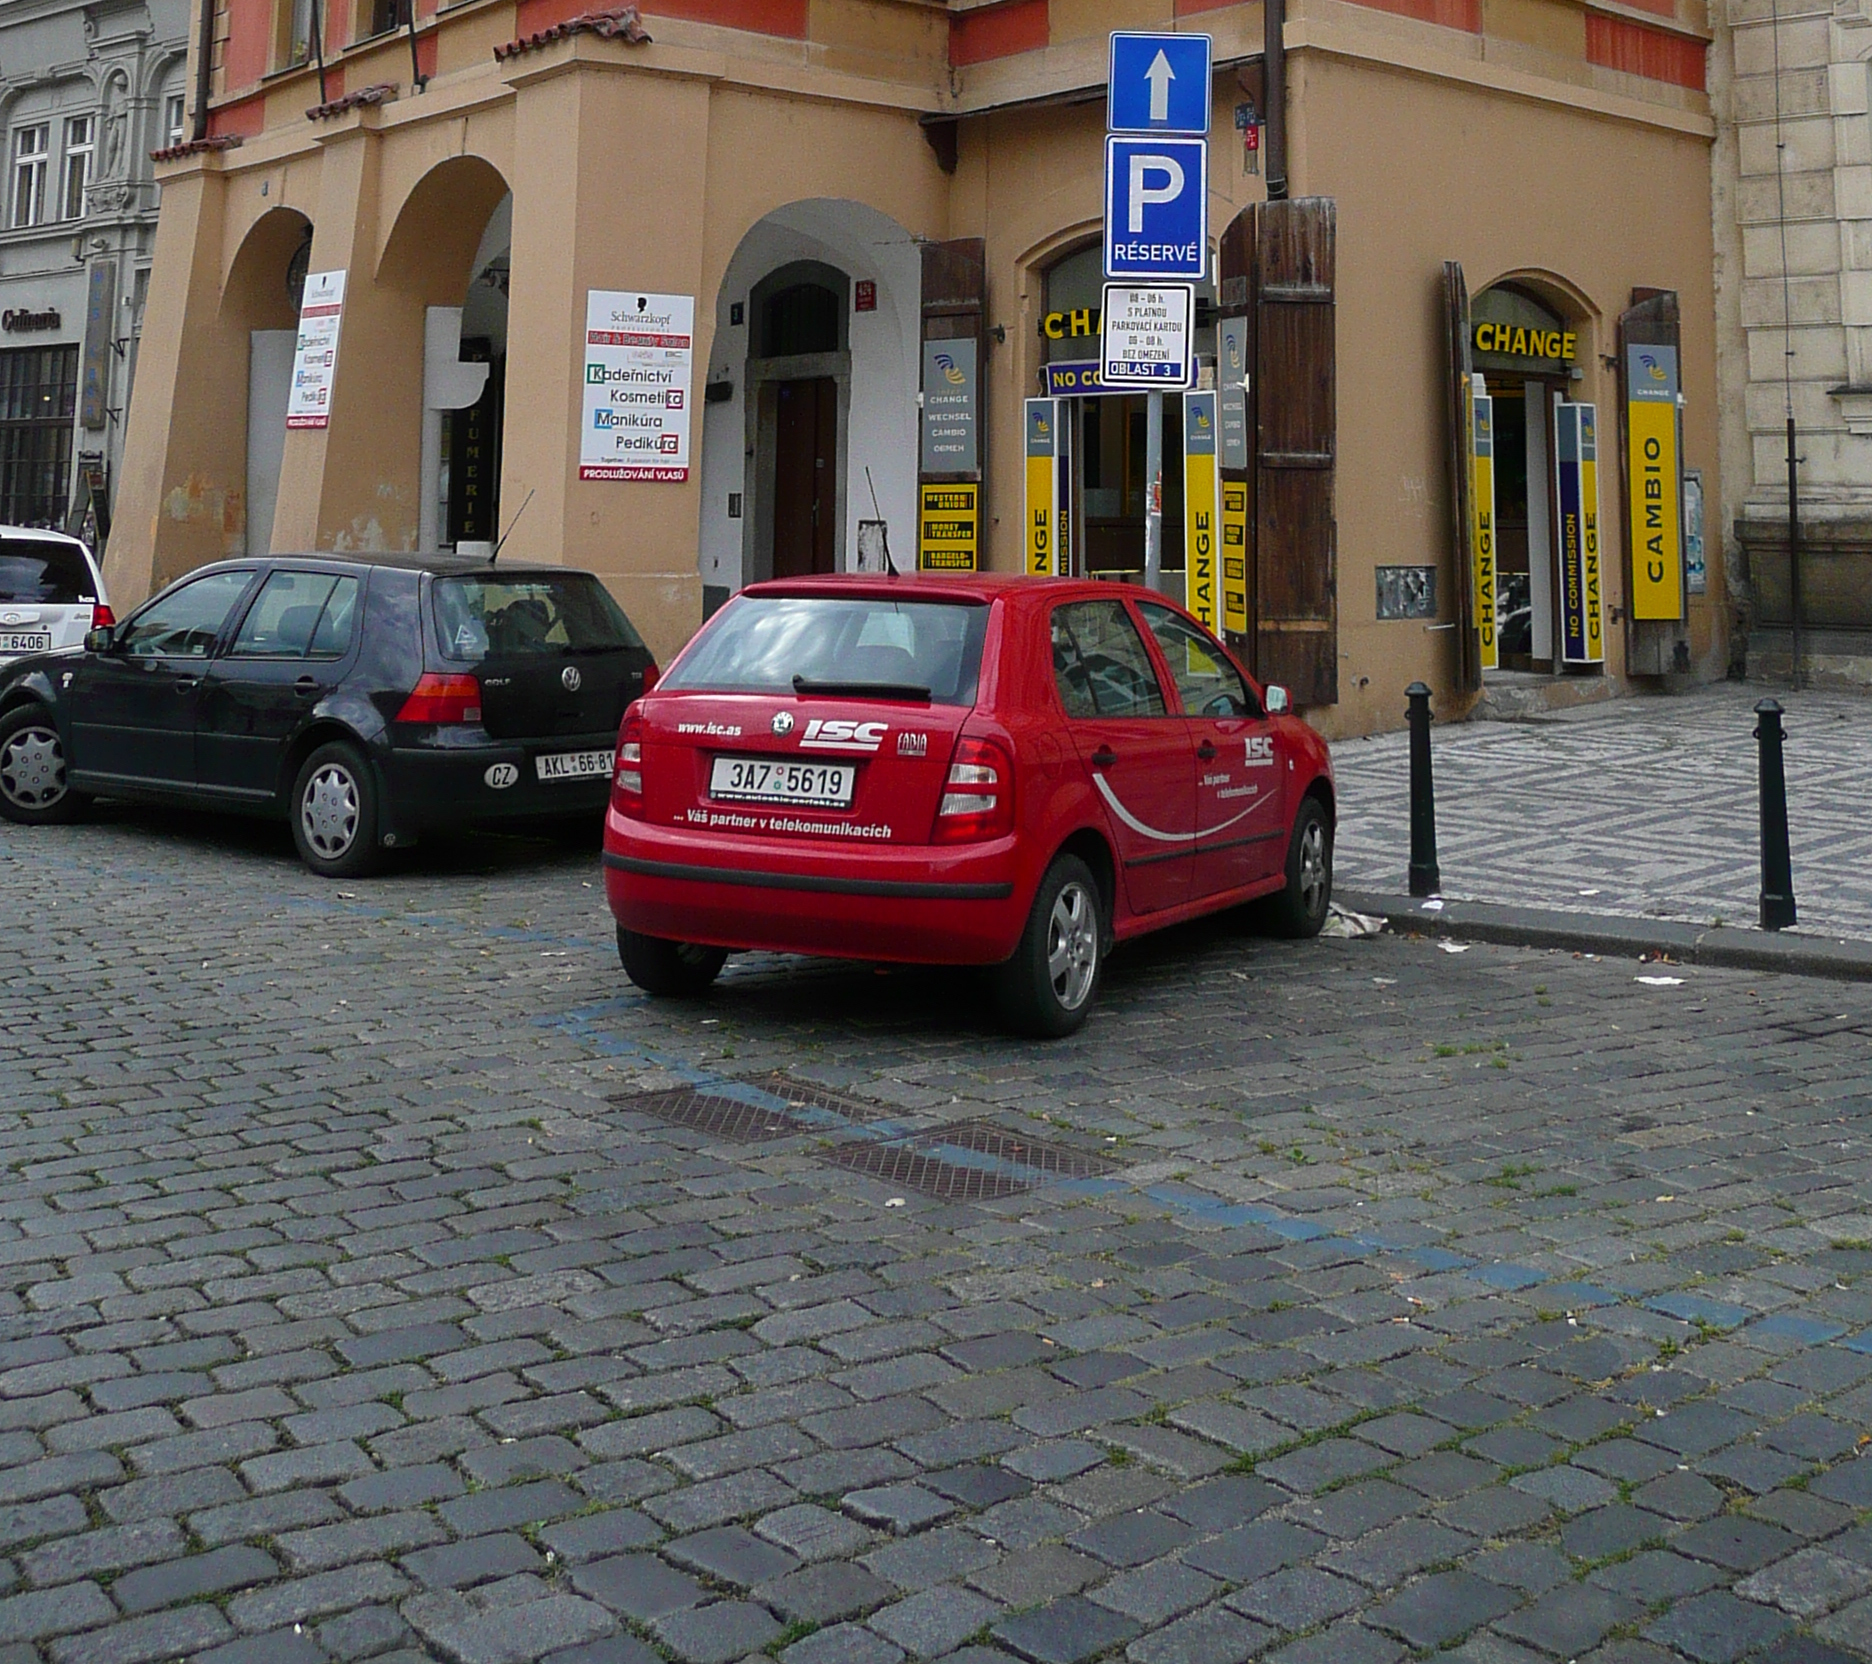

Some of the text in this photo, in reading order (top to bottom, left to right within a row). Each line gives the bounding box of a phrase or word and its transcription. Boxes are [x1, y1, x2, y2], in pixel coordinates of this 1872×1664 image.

[1129, 155, 1185, 233] P
[1114, 240, 1198, 262] RÉSERVÉ
[611, 311, 672, 327] Schwarzkopf
[1127, 307, 1167, 318] S PLATNOU
[1111, 319, 1183, 333] PARKOVACÍ KARTOU
[1475, 323, 1577, 360] CHANGE
[1122, 348, 1170, 360] BEZ OMEZENÍ
[593, 368, 673, 383] Kadeřnictví
[1110, 362, 1171, 376] OBLAST 3
[1053, 372, 1077, 387] NO
[610, 389, 682, 404] Kosmetika
[930, 395, 969, 404] CHANGE
[1637, 389, 1670, 397] CHANGE
[597, 412, 663, 428] Manikúra
[928, 412, 972, 421] WECHSEL
[932, 428, 967, 437] CAMBIO
[616, 436, 677, 450] Pedikúra
[584, 467, 655, 480] PRODLUŽOVÁNÍ
[1644, 437, 1664, 583] CAMBIO
[931, 530, 972, 538] TRANSFER
[1034, 509, 1047, 572] NGE
[1479, 511, 1493, 647] CHANGE
[1566, 513, 1580, 638] NO COMMISSION
[1585, 512, 1600, 641] CHANGE
[11, 636, 44, 649] 6406
[484, 678, 511, 686] GOLF
[678, 721, 742, 736] www.isc.as
[803, 719, 889, 743] ISC
[897, 732, 928, 750] FABIA
[1244, 737, 1274, 758] ISC
[544, 758, 570, 776] AKL
[493, 766, 512, 786] CZ
[730, 764, 843, 795] 3A7 5619
[687, 809, 708, 823] Váš
[710, 813, 757, 829] partner
[759, 819, 766, 829] v
[769, 818, 892, 838] telekomunikacích
